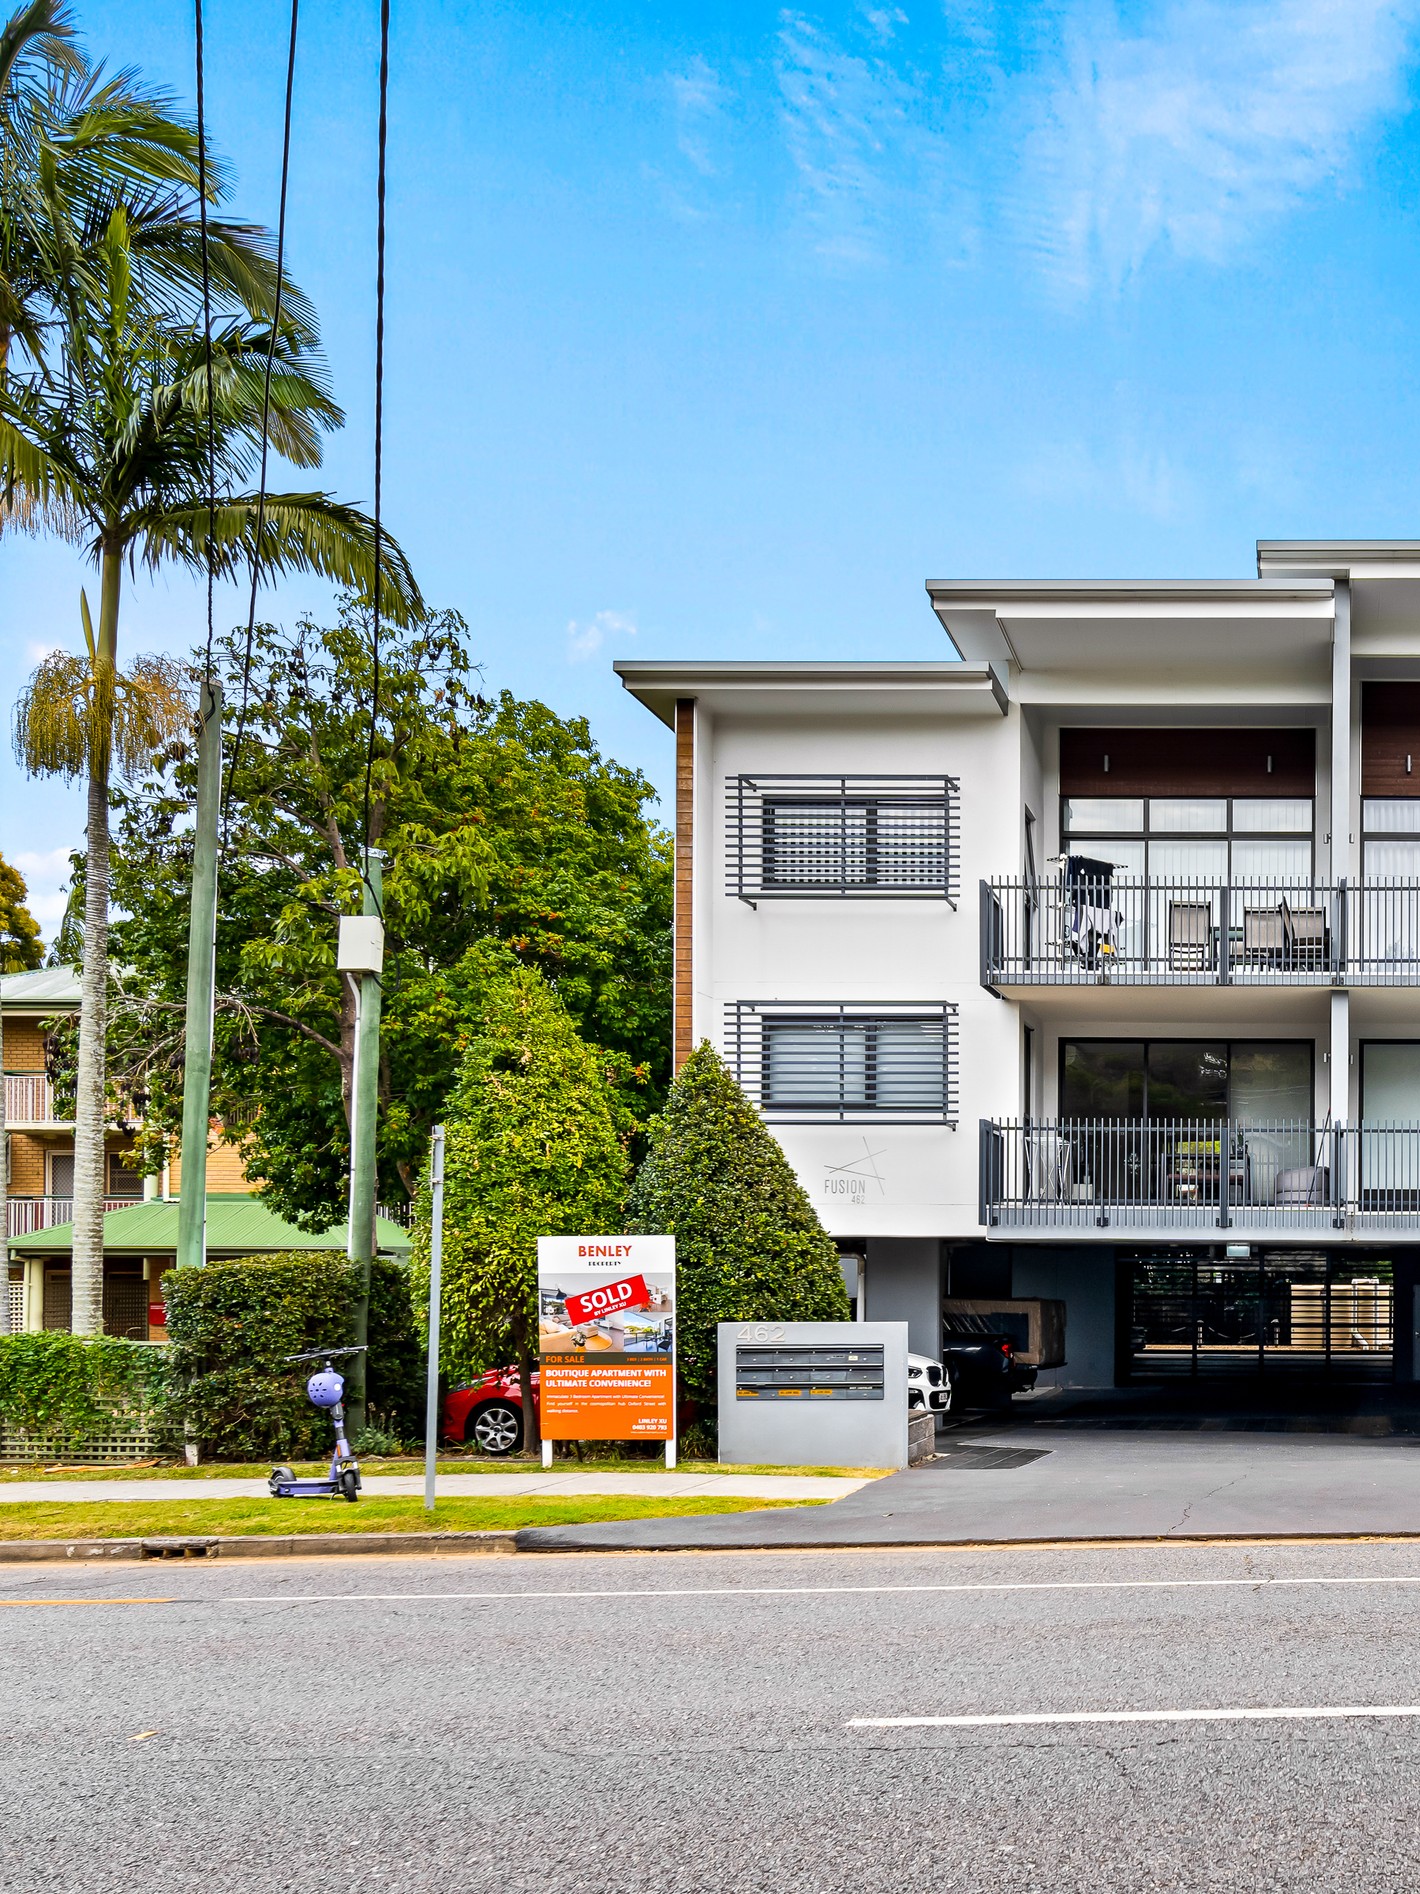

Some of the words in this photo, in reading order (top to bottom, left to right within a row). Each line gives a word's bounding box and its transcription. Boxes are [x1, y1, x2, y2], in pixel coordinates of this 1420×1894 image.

[824, 1179, 866, 1194] FUSION
[851, 1194, 865, 1204] 462
[578, 1245, 633, 1257] BENLEY
[580, 1283, 633, 1313] SOLD
[602, 1304, 620, 1314] LINLEY
[736, 1324, 786, 1343] 462
[545, 1355, 563, 1364] FOR
[564, 1355, 585, 1363] SALE
[545, 1369, 589, 1378] BOUTIQUE
[590, 1369, 643, 1377] APARTMENT
[643, 1369, 667, 1377] WITH
[545, 1379, 587, 1387] ULTIMATE
[588, 1379, 651, 1387] CONVENIENCE!
